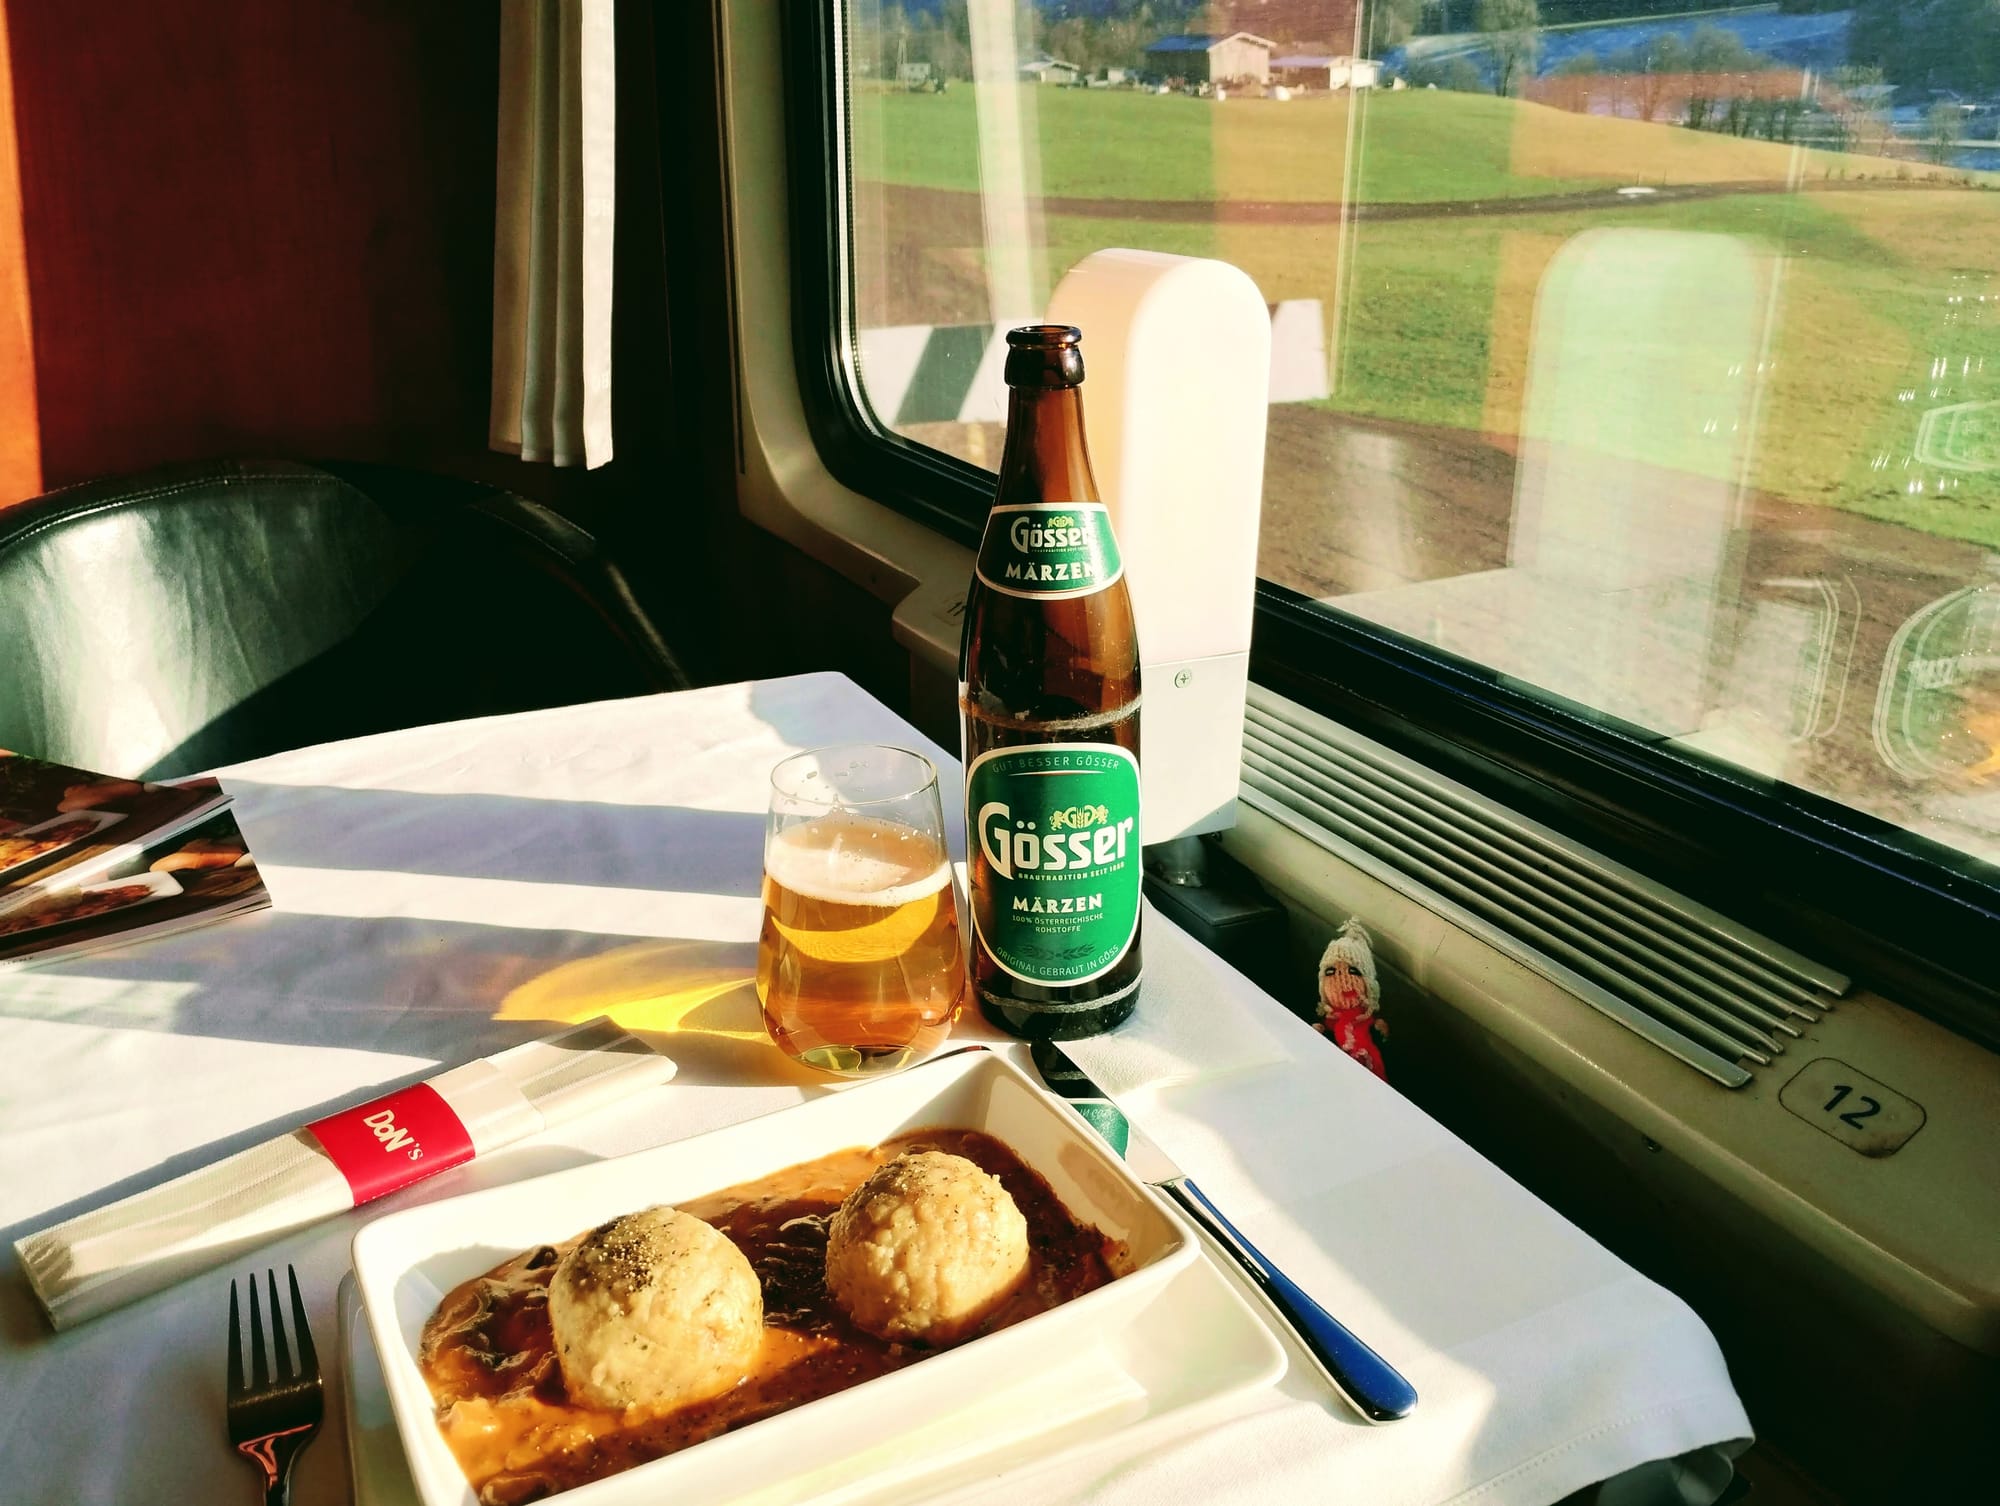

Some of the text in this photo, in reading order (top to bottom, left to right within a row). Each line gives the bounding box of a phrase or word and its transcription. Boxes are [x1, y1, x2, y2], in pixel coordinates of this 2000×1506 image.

[1010, 516, 1093, 554] Gösser
[992, 754, 1120, 773] GUT BESSER GÖSSER
[978, 801, 1134, 881] Gösser
[1018, 872, 1088, 881] BRAUTRADITION
[1012, 893, 1103, 914] MÄRZEN
[1012, 912, 1104, 925] 100% ÖSTERREICHISCHE
[1035, 924, 1081, 934] ROHSTOFFE
[997, 944, 1120, 977] ORIGINAL GEBRAUT IN GÖSS
[1823, 1085, 1881, 1130] 12
